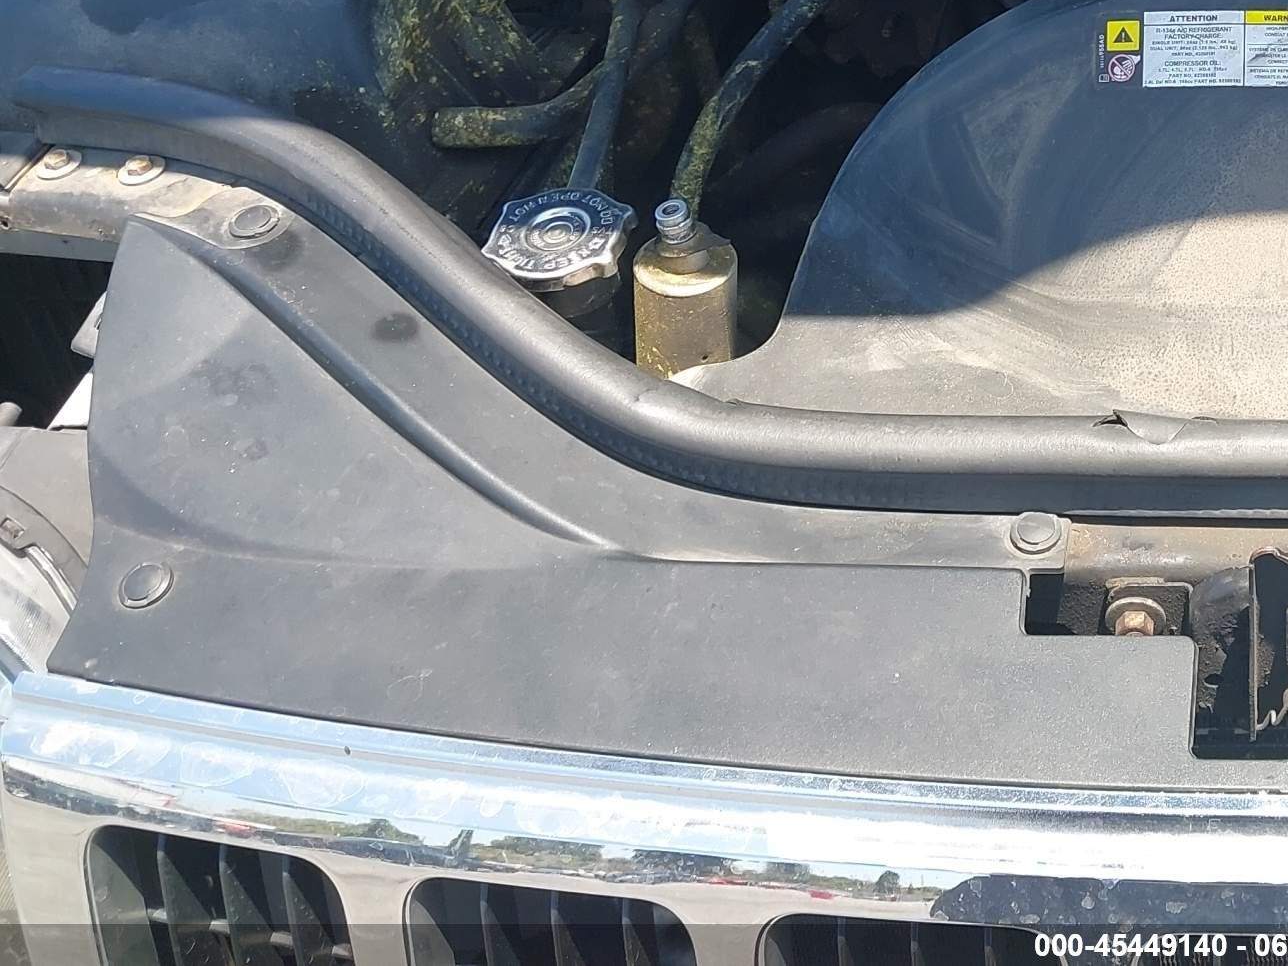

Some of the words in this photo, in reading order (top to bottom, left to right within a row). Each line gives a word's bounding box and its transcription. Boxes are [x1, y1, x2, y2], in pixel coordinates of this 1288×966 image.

[538, 192, 581, 206] OPEN
[498, 248, 536, 270] TIGHT
[544, 248, 592, 270] KEEP
